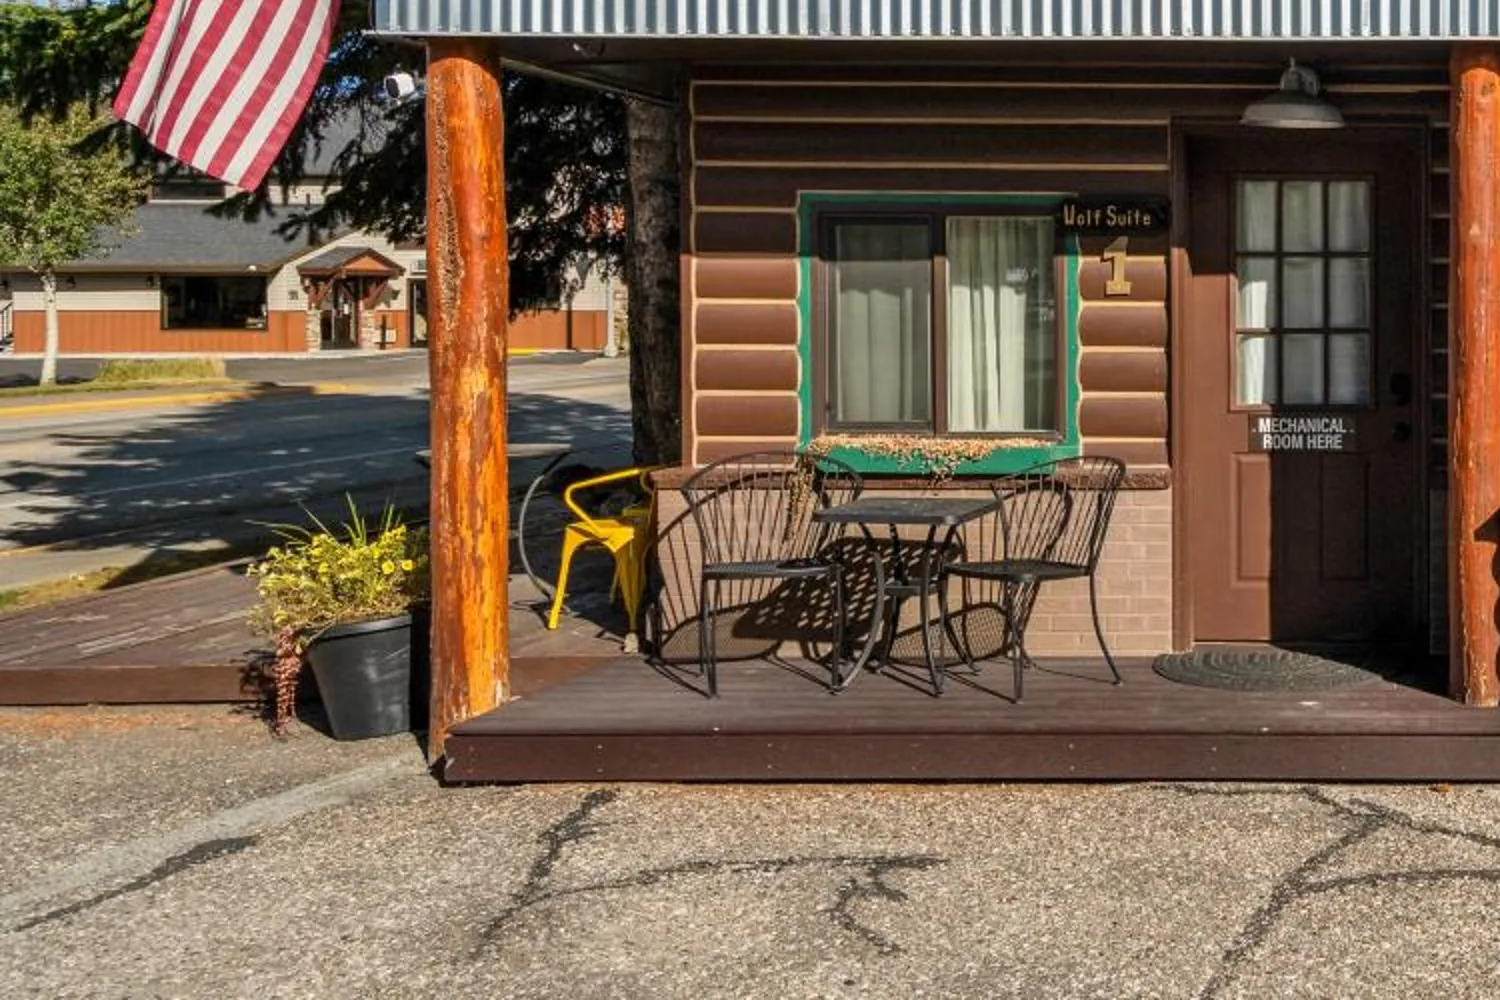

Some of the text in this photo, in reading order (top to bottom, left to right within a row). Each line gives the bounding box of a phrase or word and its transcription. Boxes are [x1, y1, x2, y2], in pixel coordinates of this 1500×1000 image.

[1063, 203, 1152, 227] Wolf Suite
[1103, 235, 1134, 296] 1
[1258, 416, 1348, 433] MECHANICAL
[1263, 433, 1344, 450] ROOM HERE
